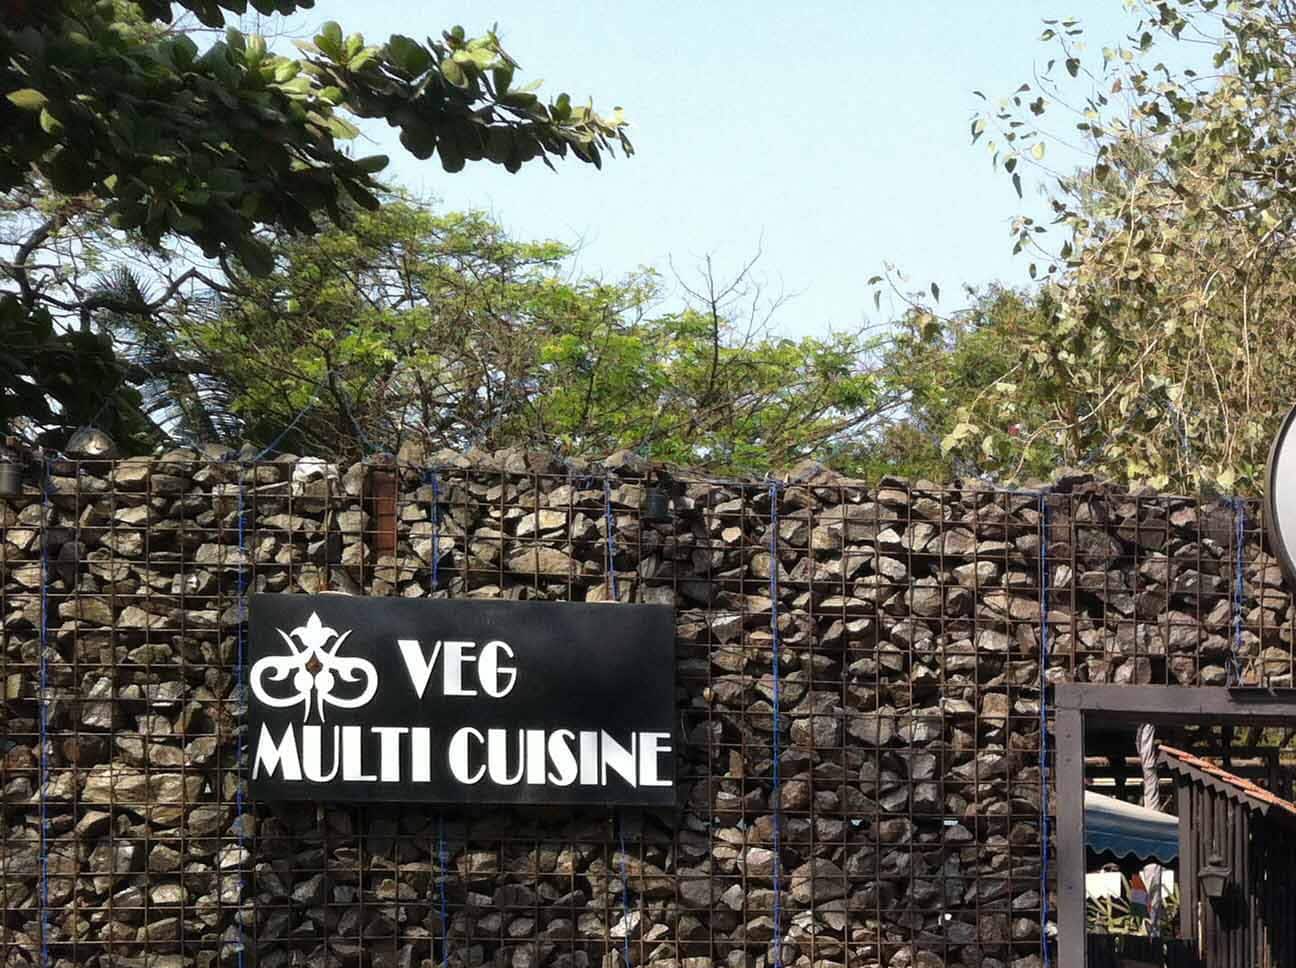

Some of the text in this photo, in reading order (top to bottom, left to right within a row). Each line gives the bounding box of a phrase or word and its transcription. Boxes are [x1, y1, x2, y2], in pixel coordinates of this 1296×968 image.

[398, 640, 517, 699] VEG
[253, 722, 673, 788] MULTI CUISINE
